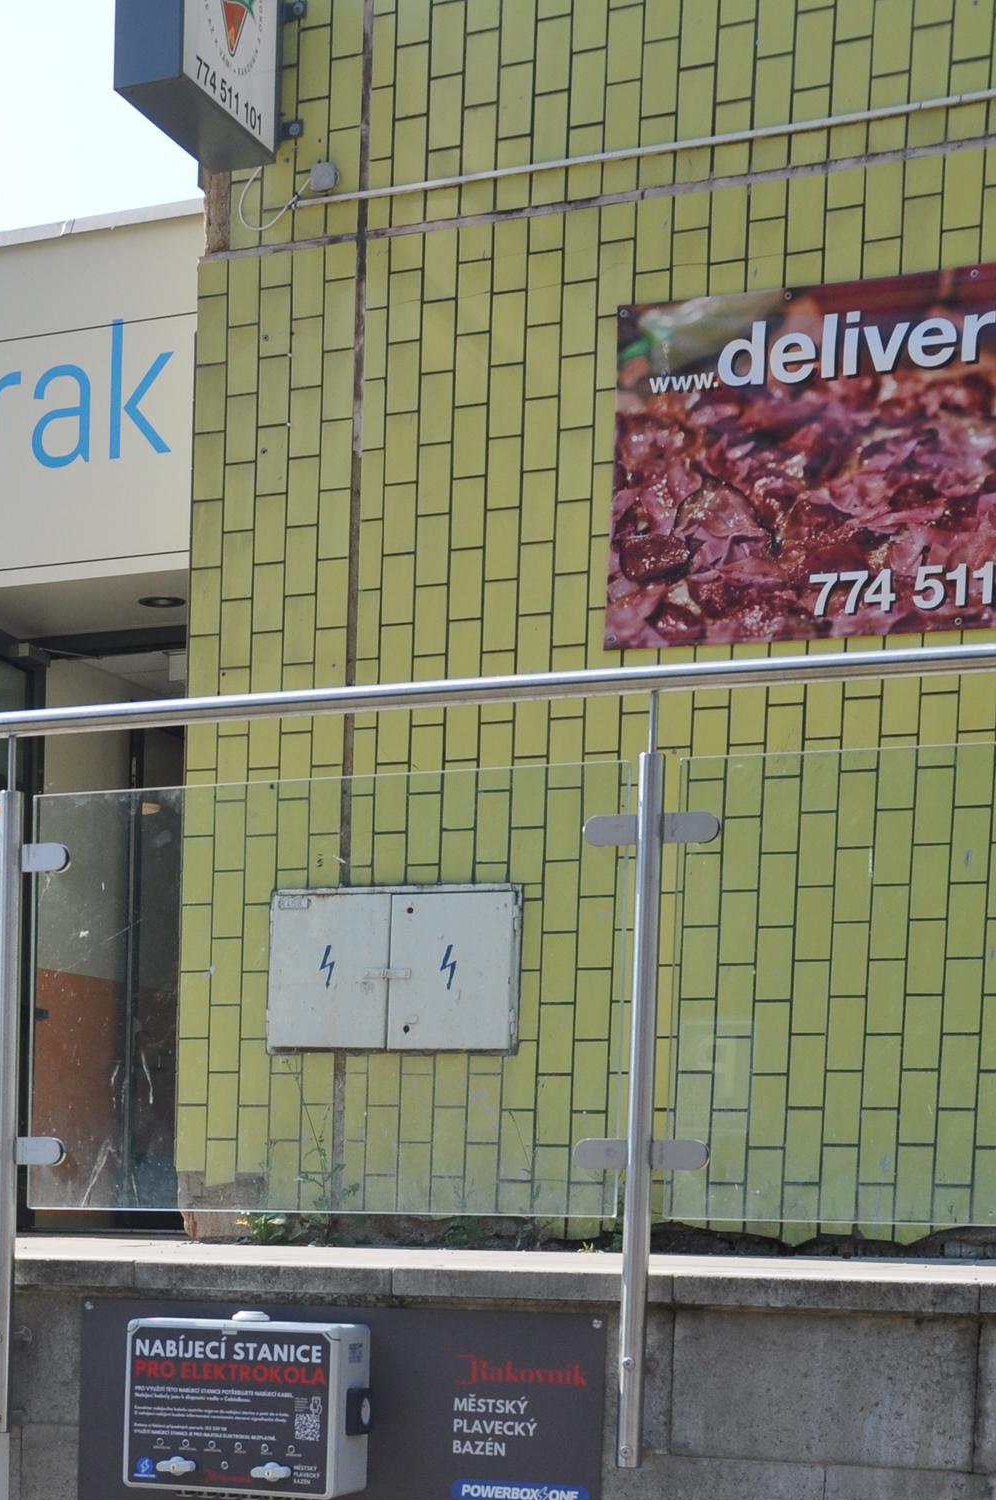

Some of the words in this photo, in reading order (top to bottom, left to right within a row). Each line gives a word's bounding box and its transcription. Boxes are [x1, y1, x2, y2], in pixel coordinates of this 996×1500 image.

[196, 54, 217, 94] 774
[220, 78, 239, 115] 511
[244, 101, 262, 136] 101
[808, 568, 896, 617] 774
[912, 560, 996, 610] 511
[135, 1335, 228, 1359] NABÍJECÍ
[233, 1342, 322, 1364] STANICE
[134, 1359, 175, 1379] PRO
[179, 1361, 326, 1385] ELEKTROKOLA
[453, 1394, 529, 1415] MĚSTSKÝ
[453, 1418, 538, 1437] PLAVECKÝ
[452, 1437, 506, 1456] BAZÉN
[461, 1484, 539, 1500] POWERBOX
